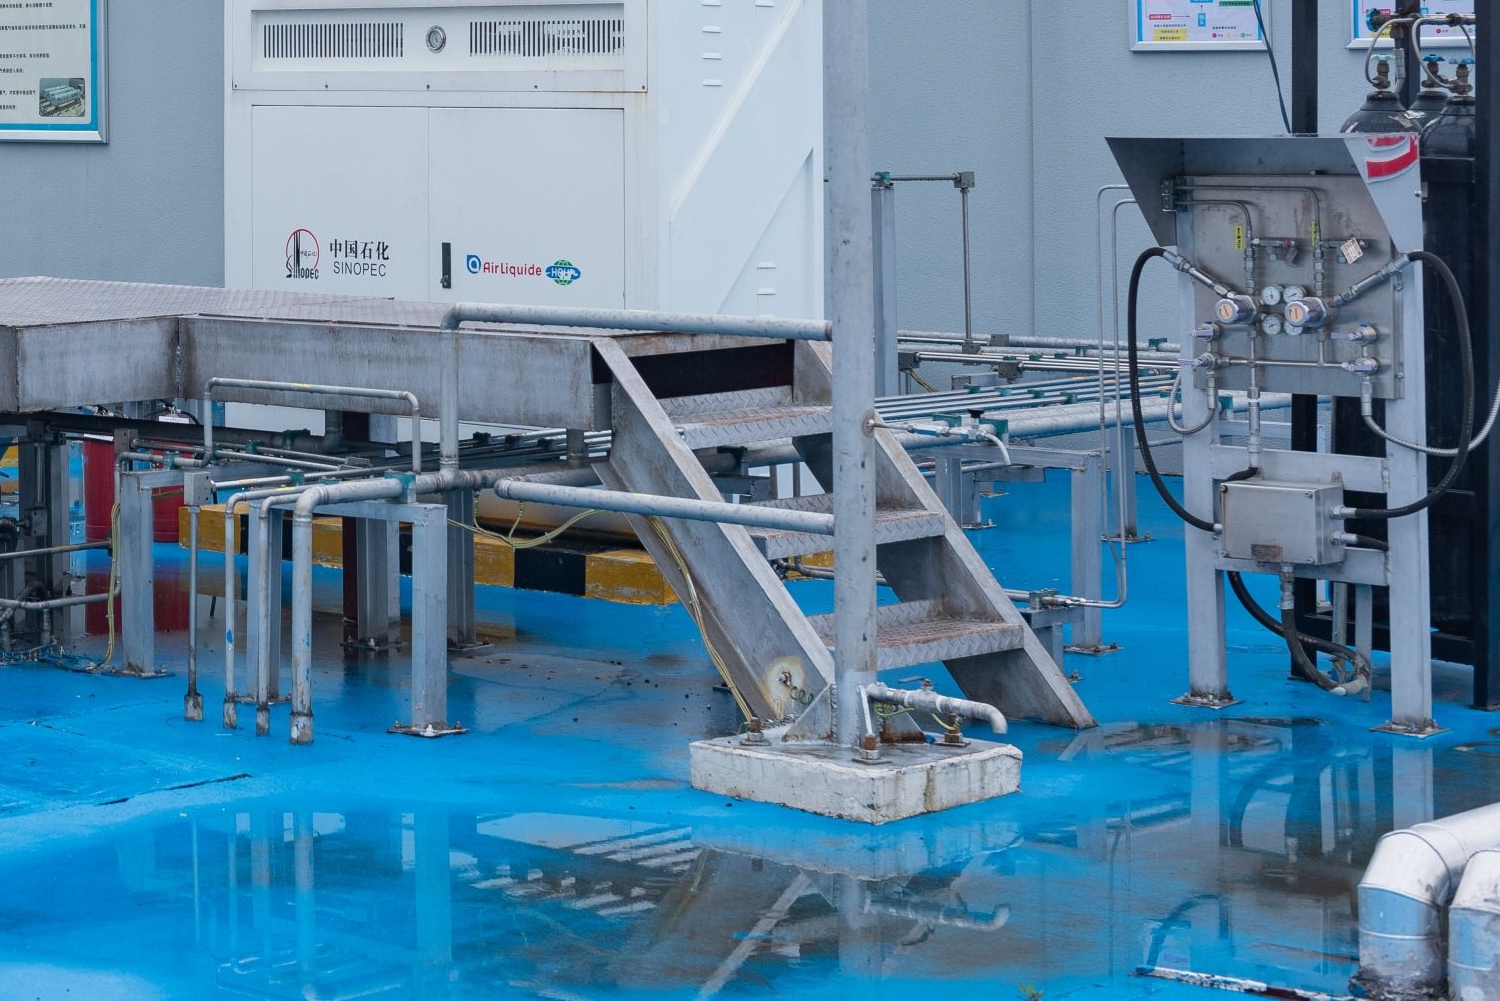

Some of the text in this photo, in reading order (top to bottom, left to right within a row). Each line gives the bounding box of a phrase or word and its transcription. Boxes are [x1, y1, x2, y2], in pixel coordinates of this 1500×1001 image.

[330, 238, 390, 260] 中国石化
[333, 261, 386, 277] SINOPEC
